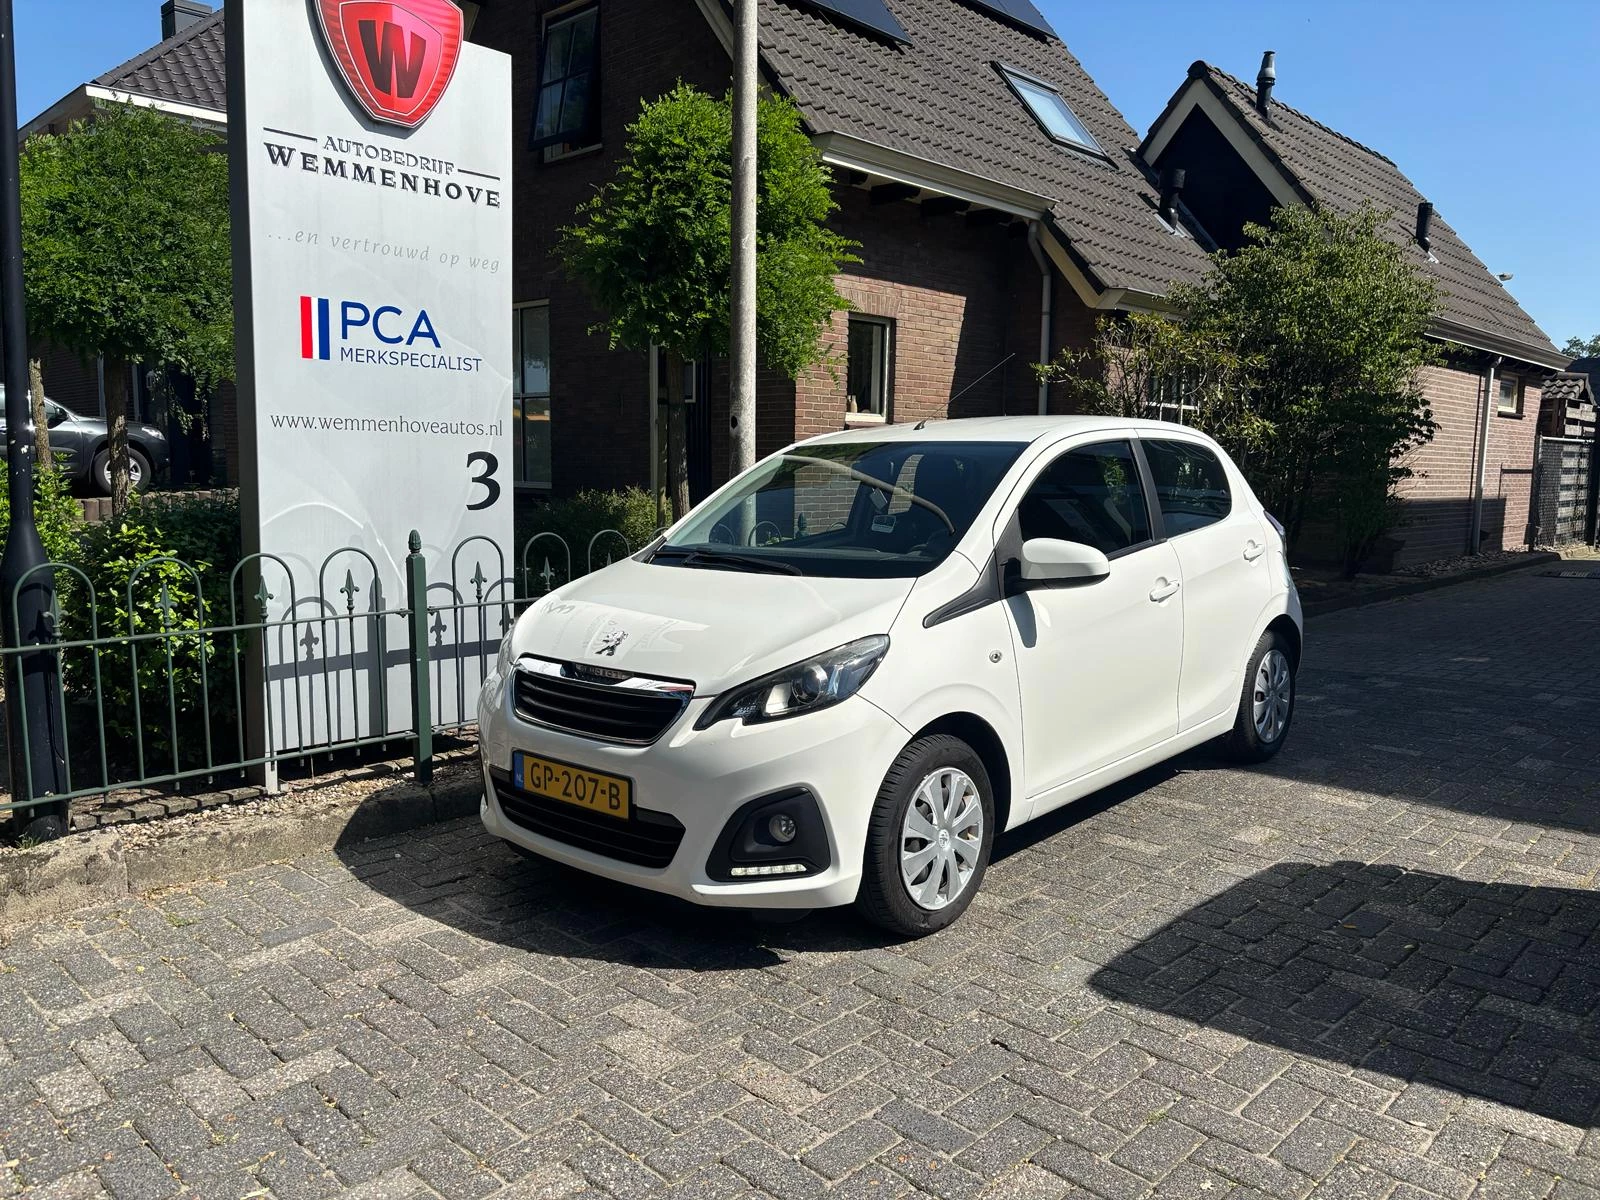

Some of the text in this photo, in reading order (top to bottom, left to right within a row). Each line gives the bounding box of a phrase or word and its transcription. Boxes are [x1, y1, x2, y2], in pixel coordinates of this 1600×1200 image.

[263, 142, 501, 209] WEMMENHOVE
[323, 136, 455, 176] AUTOBEDRIJF
[330, 234, 430, 262] vertrouwd
[439, 252, 460, 268] op
[469, 255, 501, 274] weg
[340, 300, 442, 349] PCA
[340, 347, 482, 373] MERKSPECIALIST
[270, 415, 503, 437] www.wemmenhoveautos.nl
[466, 450, 501, 511] 3
[530, 762, 622, 811] GP-207-B
